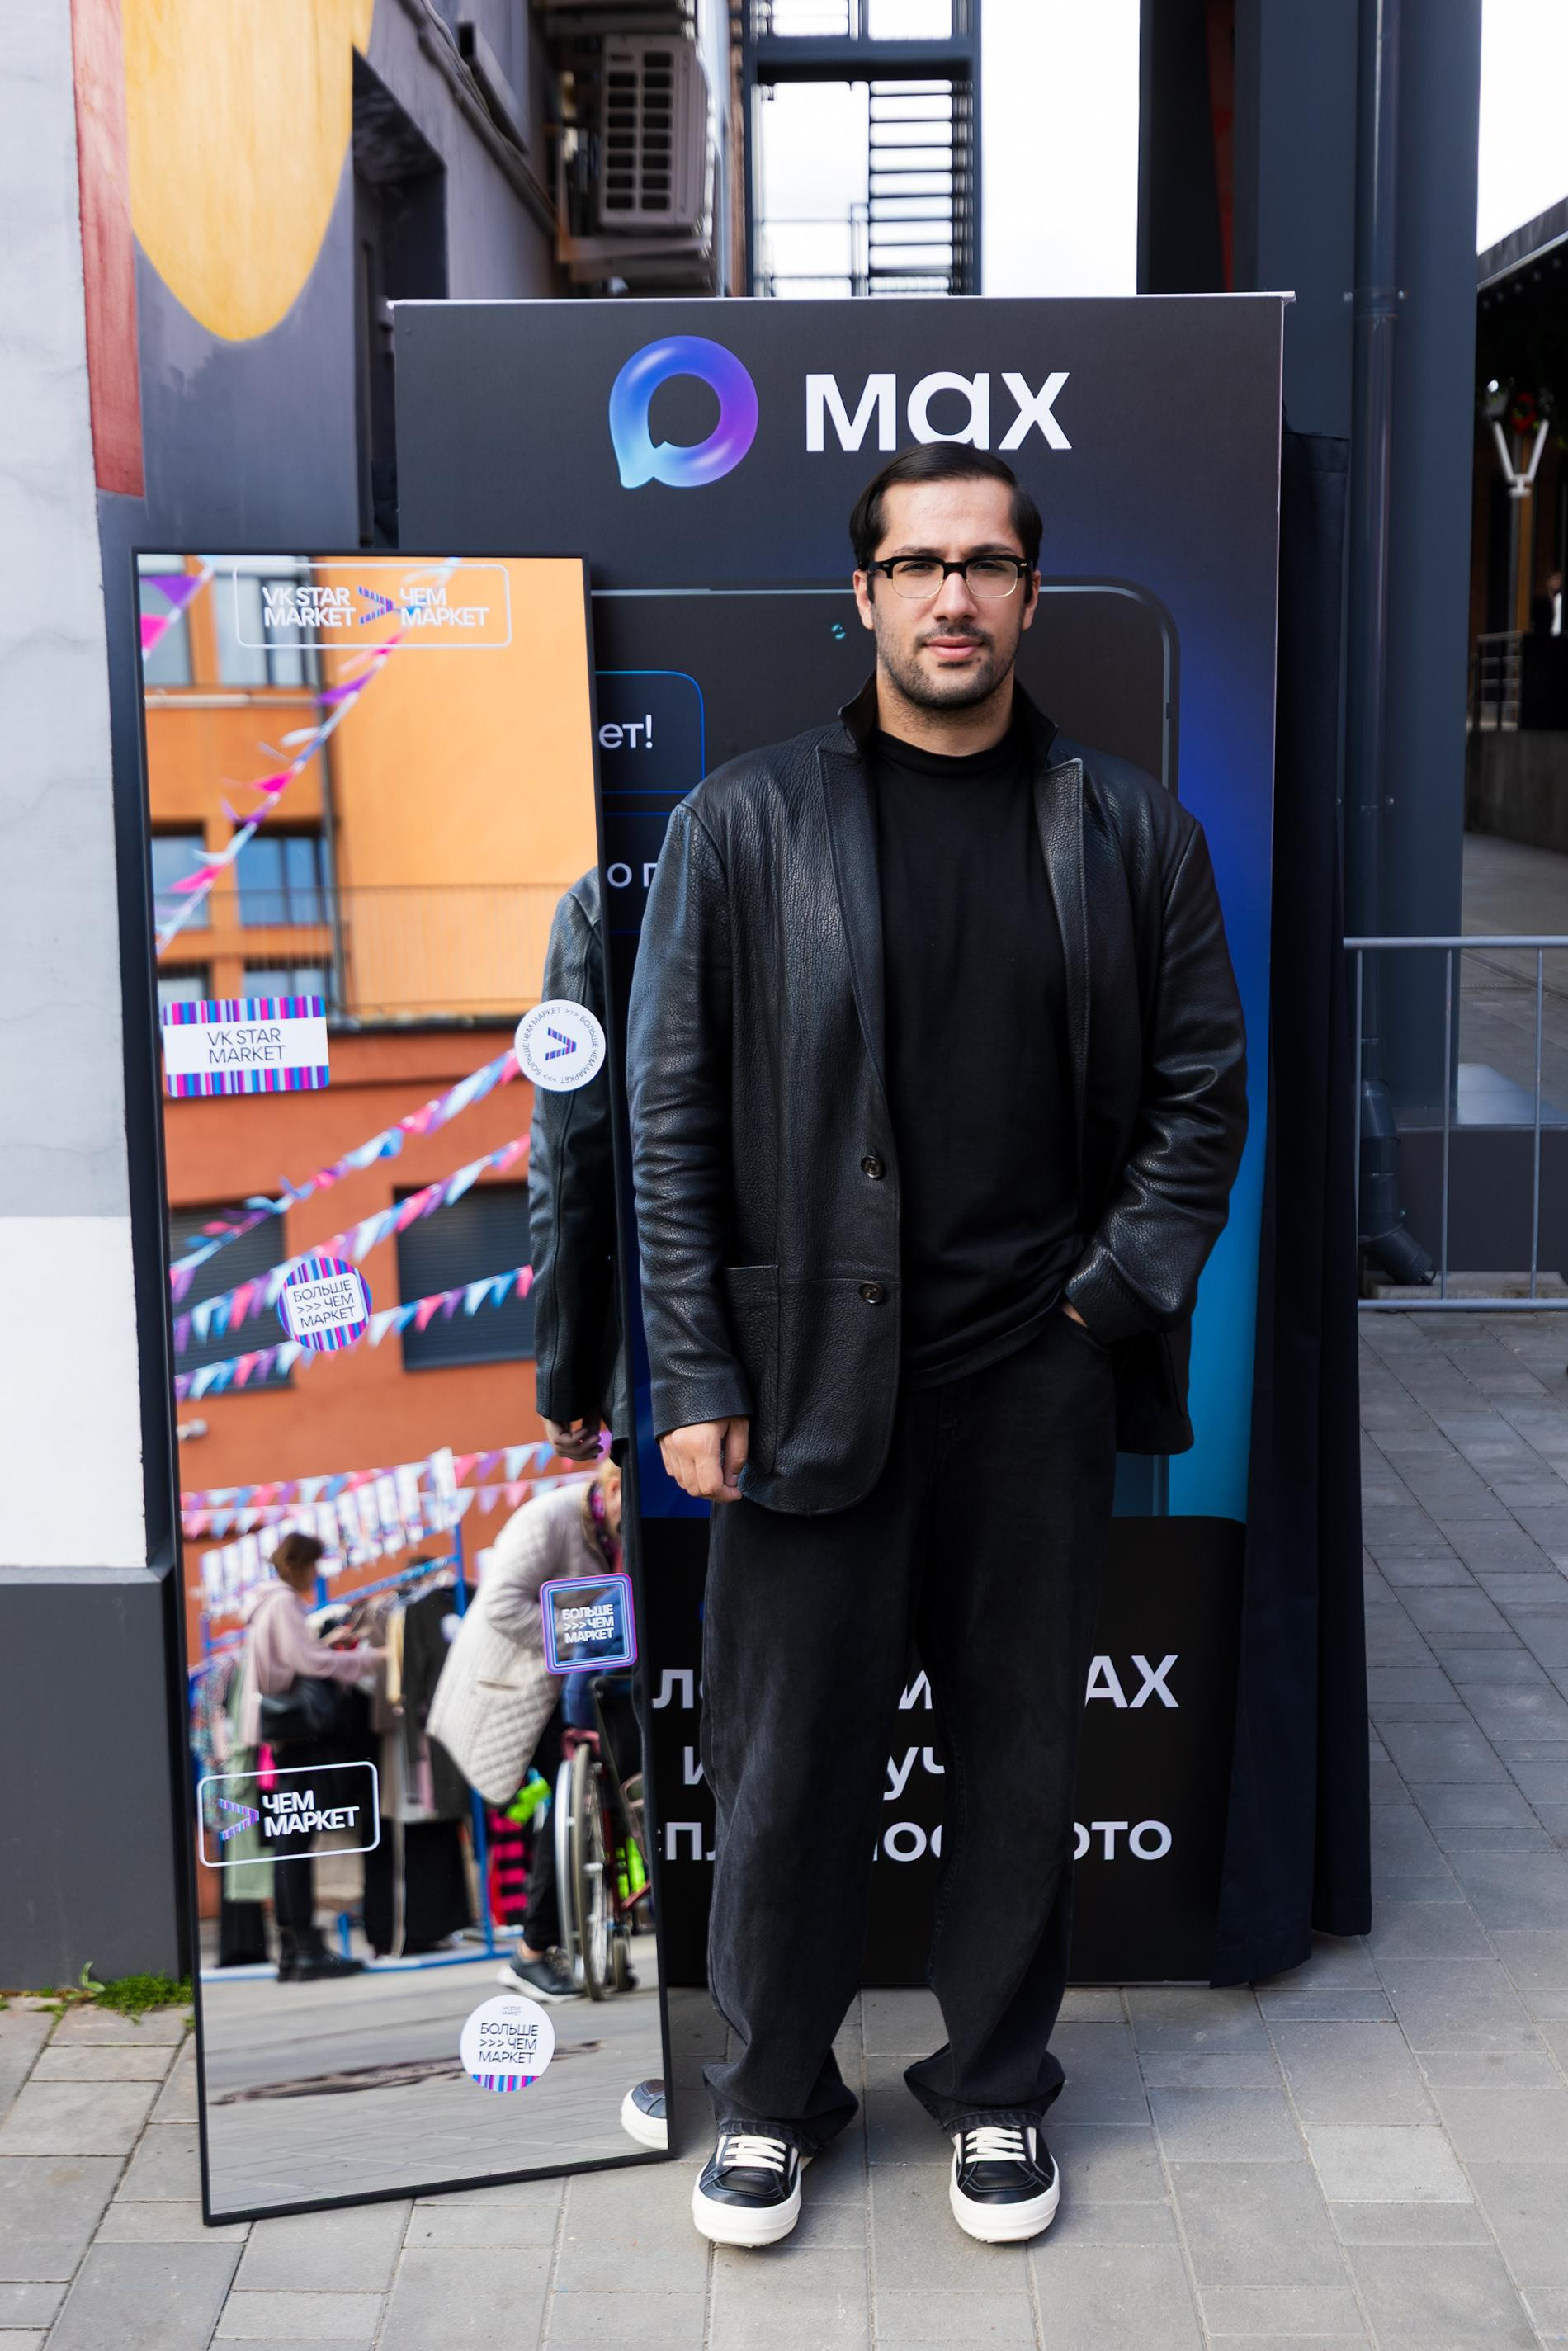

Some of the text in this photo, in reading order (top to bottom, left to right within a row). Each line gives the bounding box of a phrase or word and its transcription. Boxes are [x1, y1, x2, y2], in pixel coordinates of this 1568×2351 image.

[262, 586, 350, 607] VK STAR
[399, 587, 446, 607] ЧЕМ
[264, 607, 356, 627] MARKET
[401, 607, 489, 627] МАРКЕТ
[598, 714, 653, 748] ет!
[207, 1027, 281, 1046] VK STAR
[209, 1045, 286, 1064] MARKET
[293, 1279, 352, 1302] БОЛЬШЕ
[324, 1292, 354, 1308] ЧЕМ
[300, 1305, 355, 1329] МАРКЕТ
[561, 1603, 614, 1620] БОЛЬШЕ
[587, 1616, 614, 1628] ЧЕМ
[564, 1627, 615, 1644] МАРКЕТ
[1084, 1654, 1180, 1709] AX
[262, 1789, 315, 1815] ЧЕМ
[264, 1806, 360, 1837] МАРКЕТ
[480, 2023, 539, 2037] БОЛЬШЕ
[508, 2037, 537, 2051] ЧЕМ
[478, 2051, 535, 2064] МАРКЕТ
